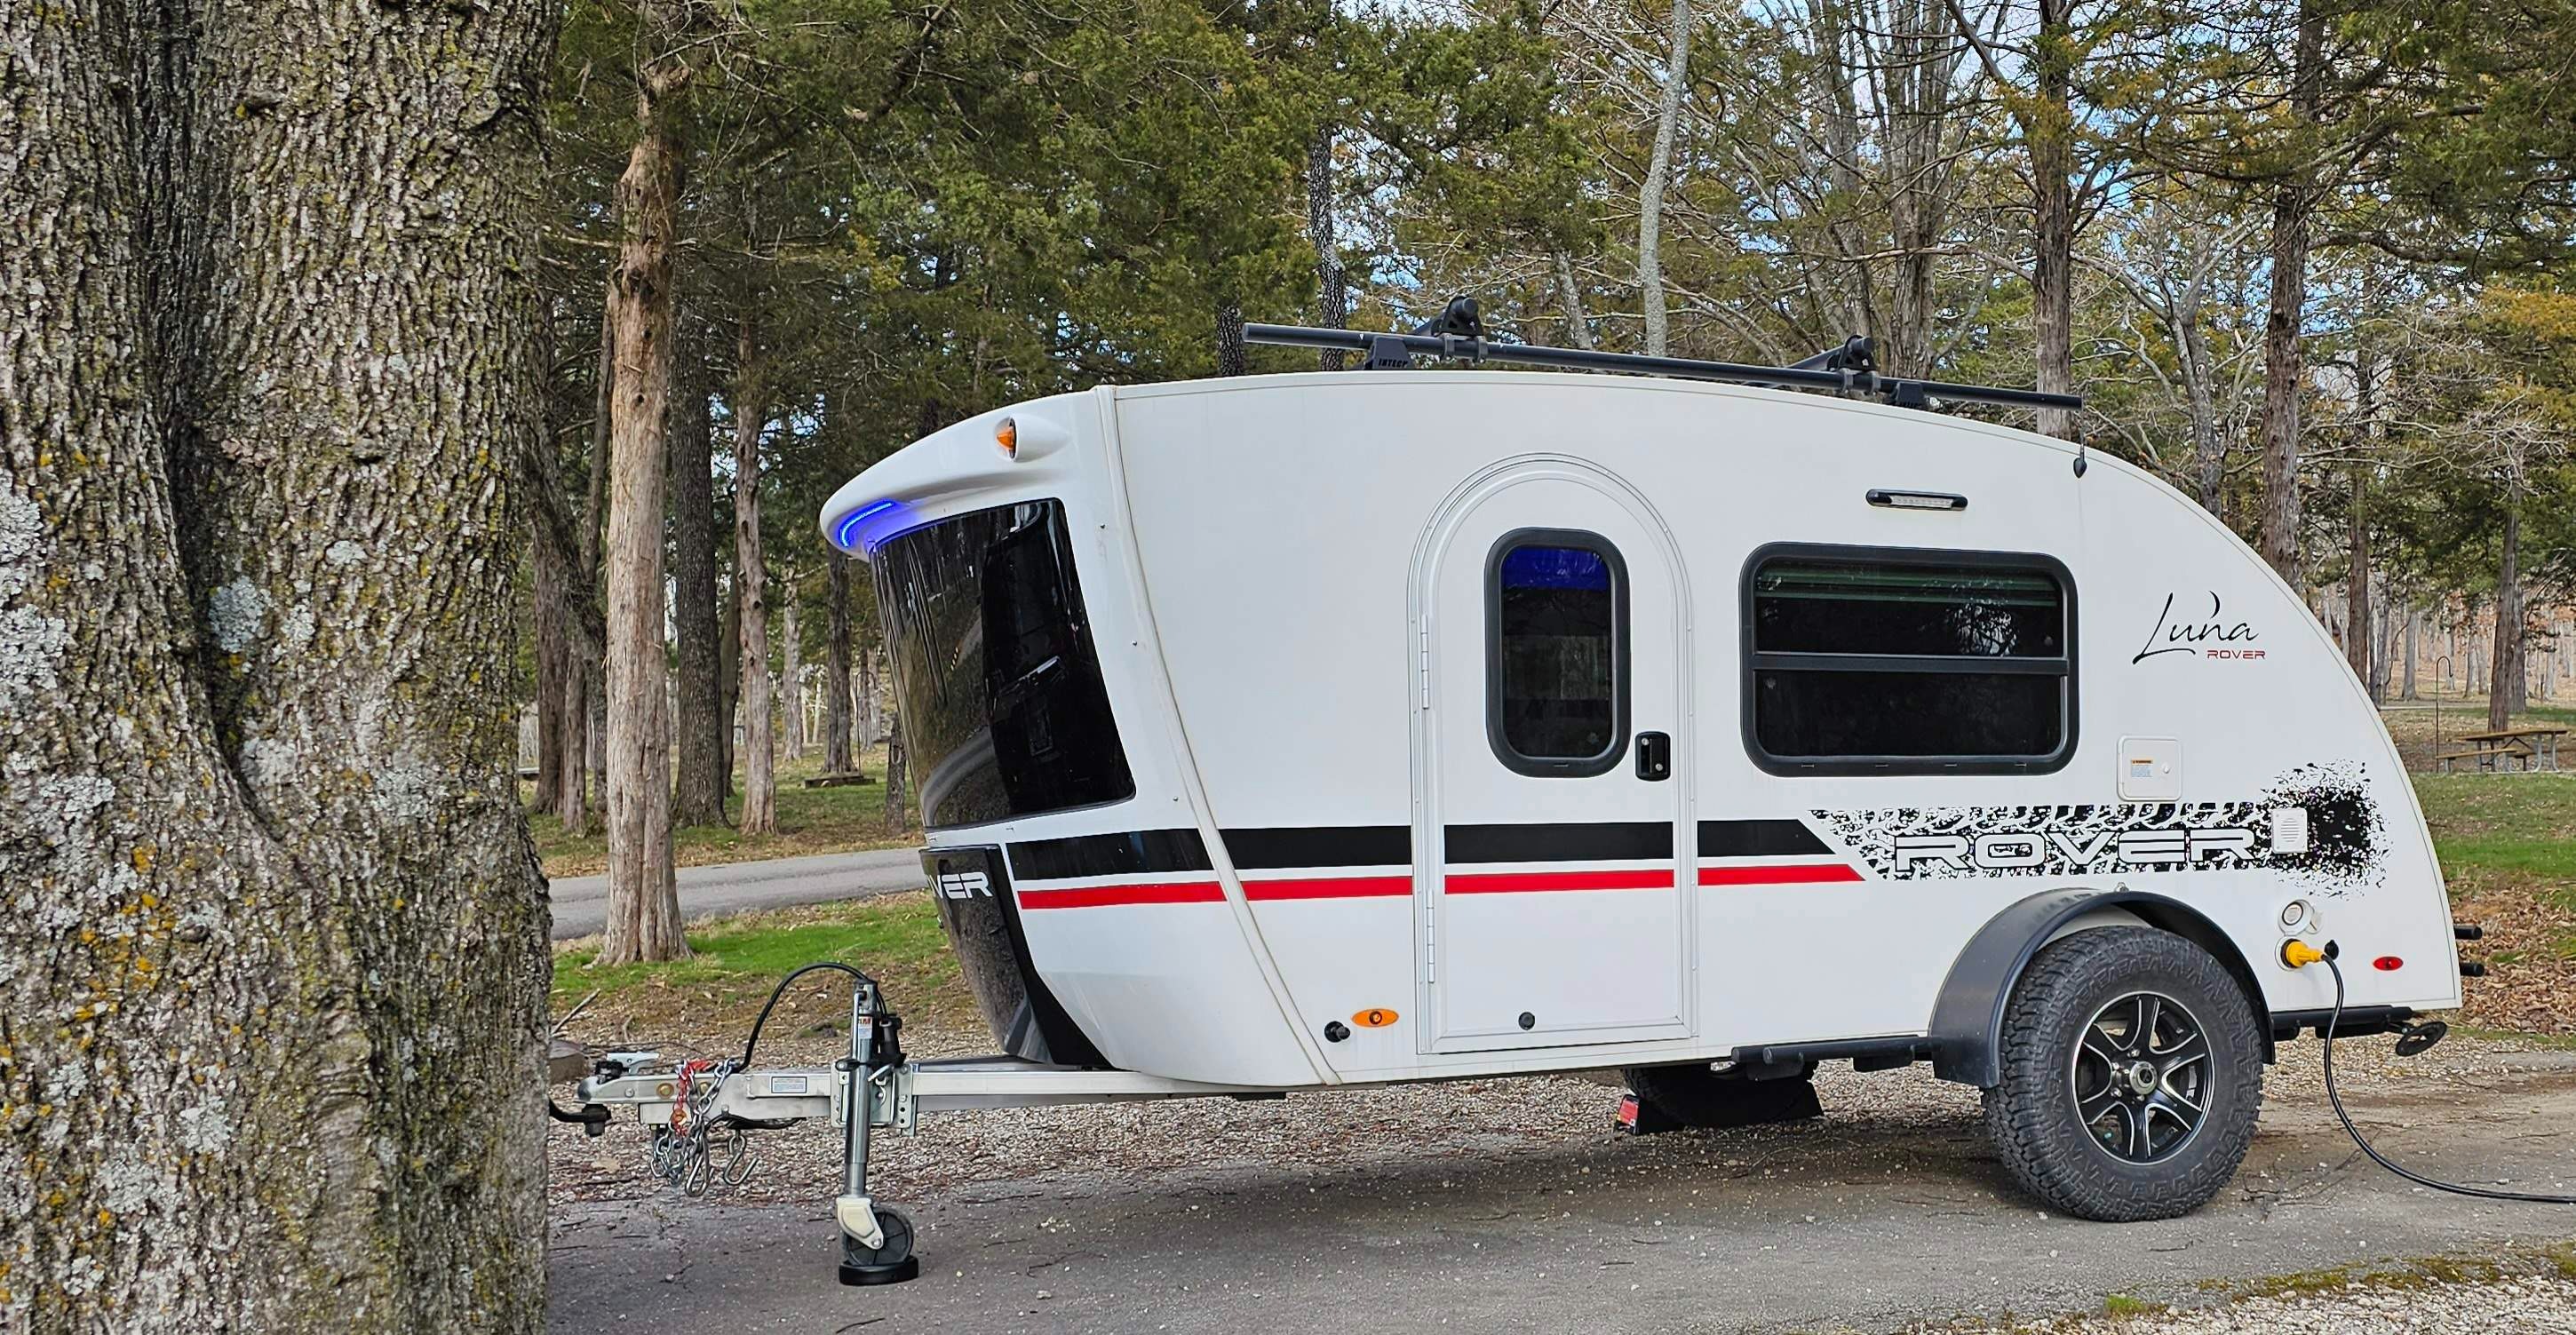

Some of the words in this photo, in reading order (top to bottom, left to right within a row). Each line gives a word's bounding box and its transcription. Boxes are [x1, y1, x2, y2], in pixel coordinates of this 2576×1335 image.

[2132, 591, 2259, 664] Luna
[2207, 649, 2265, 659] ROVER
[1895, 828, 2257, 872] ROVER
[926, 871, 993, 899] VER
